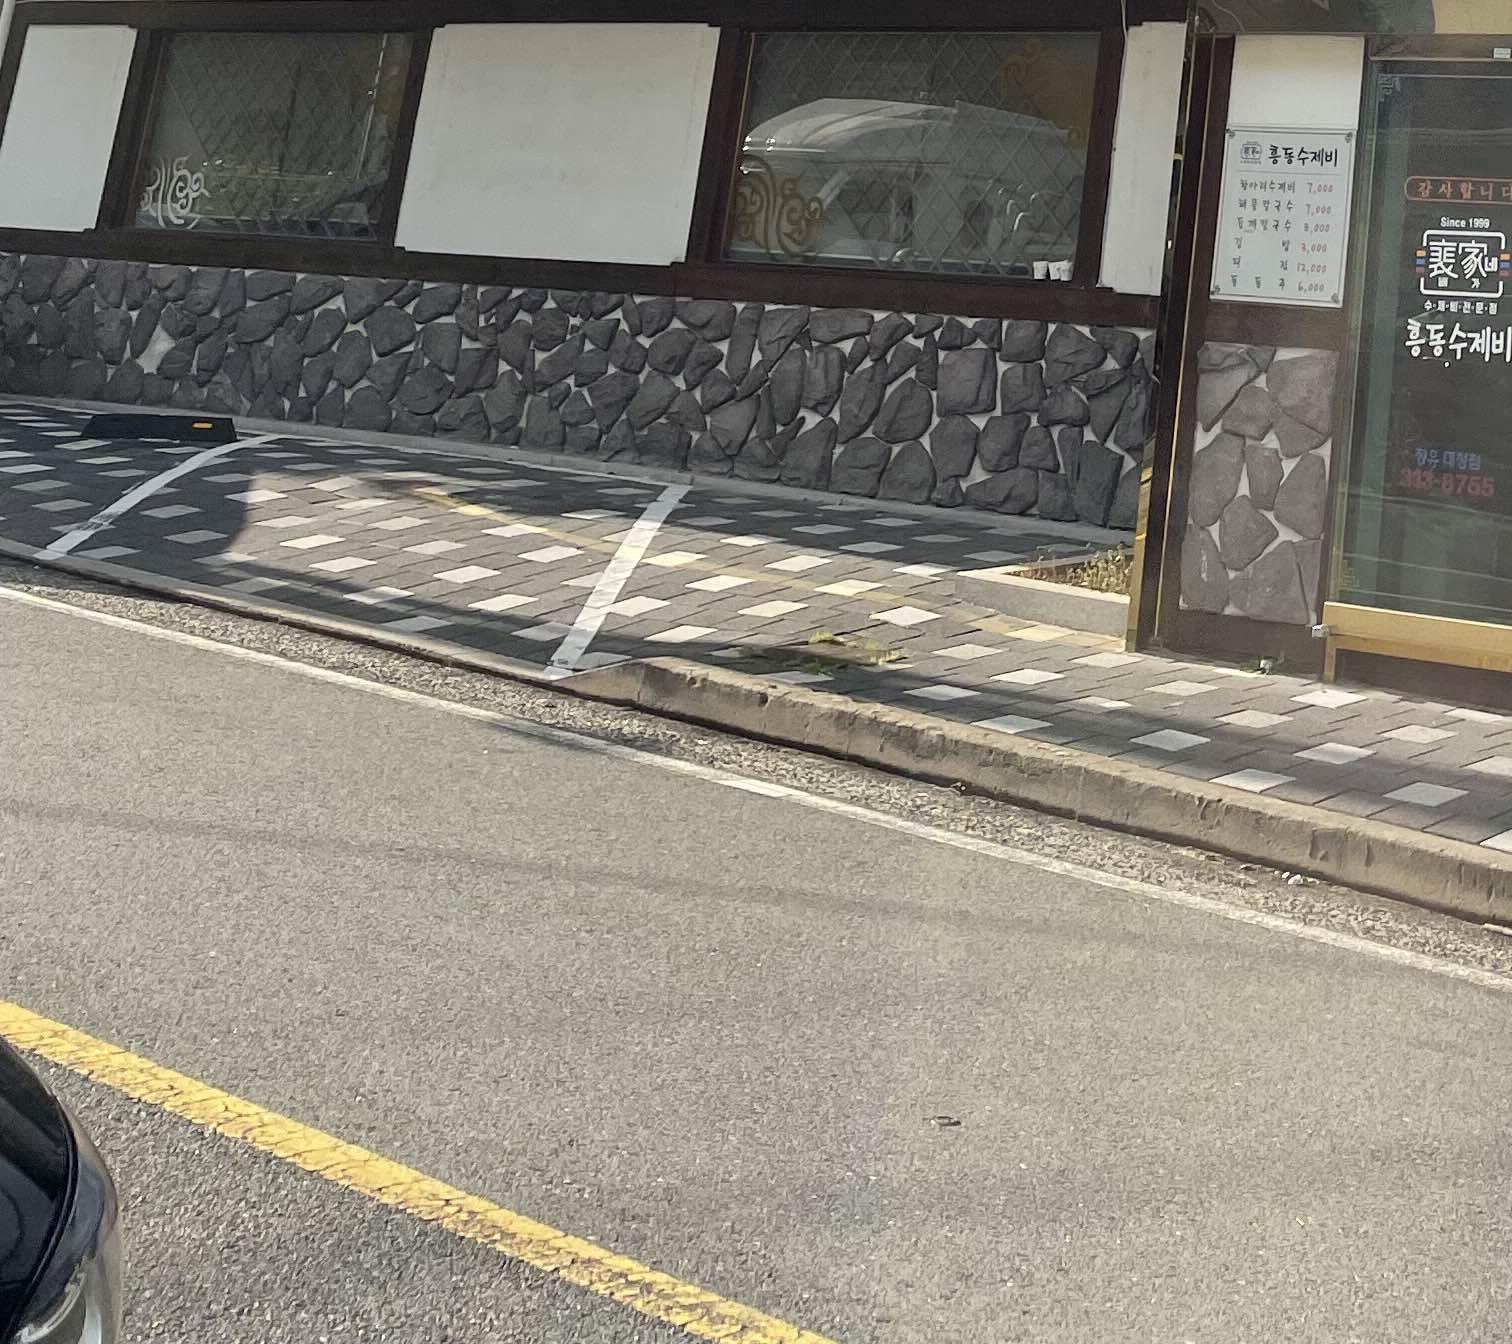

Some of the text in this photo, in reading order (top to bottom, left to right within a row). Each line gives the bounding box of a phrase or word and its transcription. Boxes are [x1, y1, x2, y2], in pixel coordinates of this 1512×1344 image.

[1268, 144, 1338, 167] 흥동수제비
[1440, 217, 1490, 229] Since 1999
[1405, 318, 1512, 363] 흥동수제비
